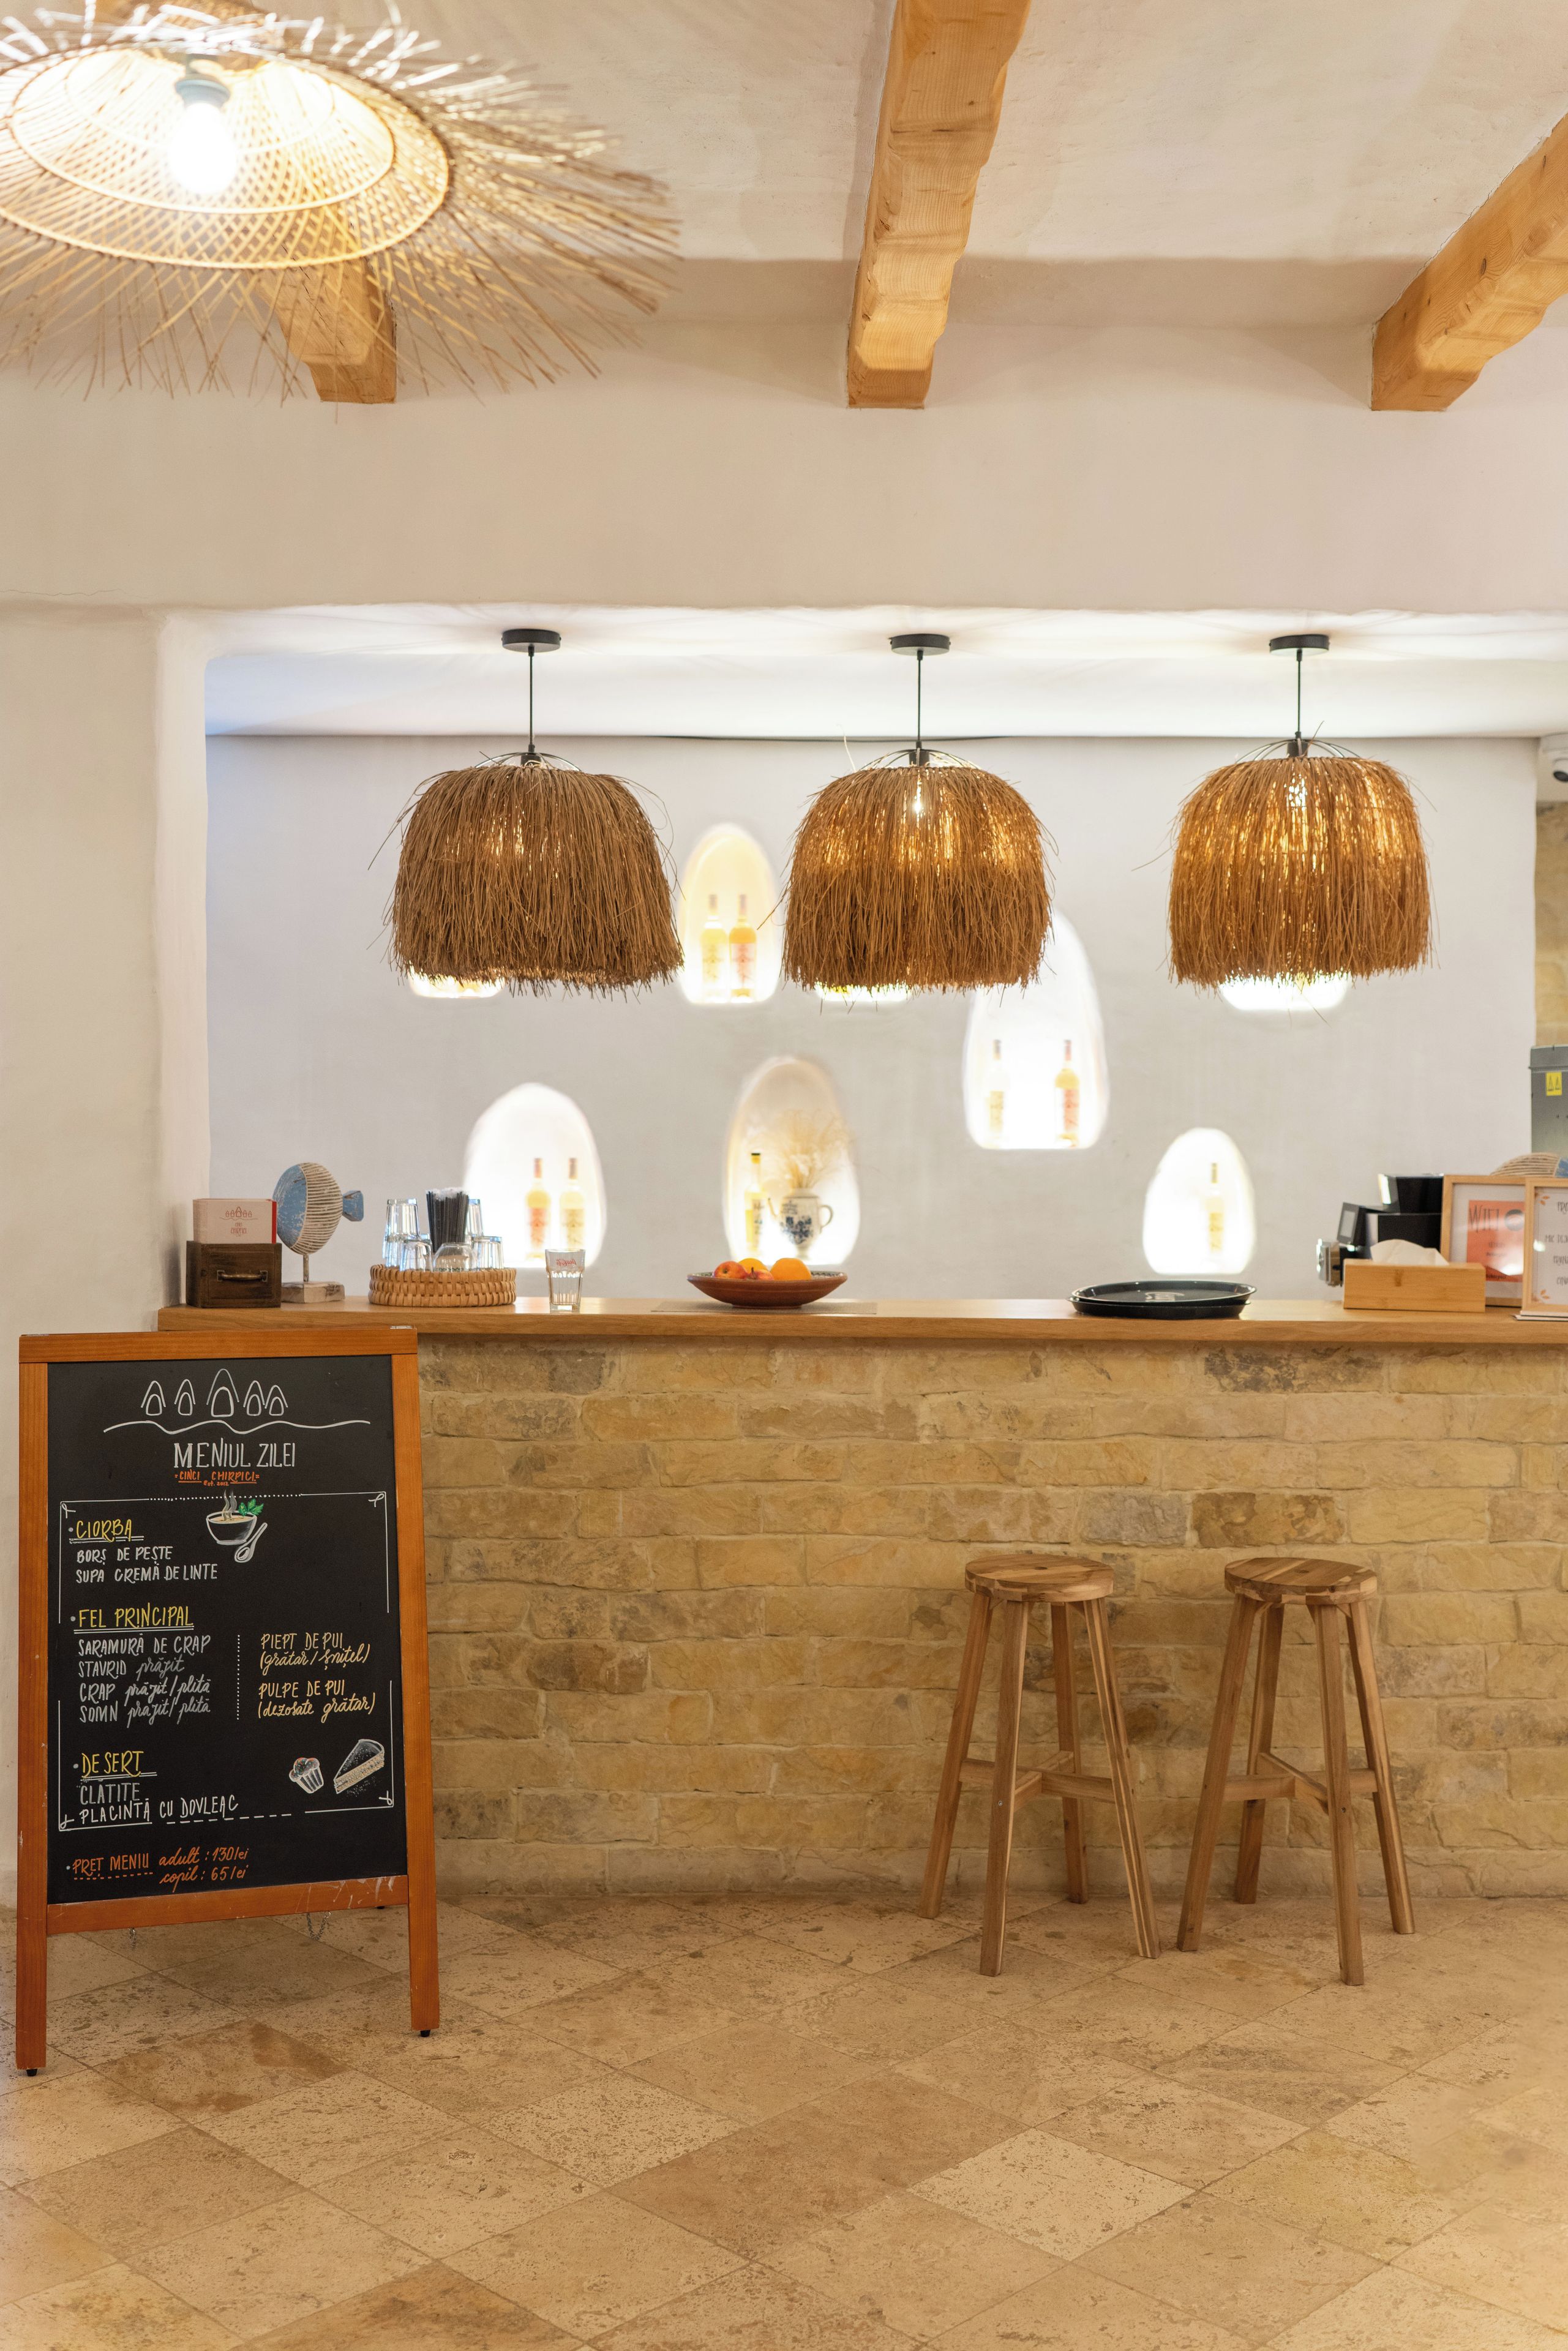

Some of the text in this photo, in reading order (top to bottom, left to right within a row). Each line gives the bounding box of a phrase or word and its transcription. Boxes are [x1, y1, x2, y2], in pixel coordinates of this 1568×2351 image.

[173, 1438, 296, 1468] MENIUL ZILEI
[179, 1469, 200, 1480] CINCI
[117, 1547, 130, 1561] DE
[76, 1569, 104, 1583] SUPA
[163, 1565, 180, 1581] DE
[184, 1564, 217, 1580] LINTE
[79, 1602, 193, 1628] FEL PRINCIPAL
[154, 1637, 167, 1654] DE
[174, 1635, 211, 1655] CRAP
[261, 1633, 297, 1649] PIEPT
[305, 1632, 319, 1651] DE
[78, 1660, 126, 1679] STAVRID
[80, 1683, 116, 1704] CRAP
[258, 1679, 345, 1700] PULPE DE PUI
[80, 1700, 118, 1723] SOMN
[160, 1800, 173, 1818] CU
[180, 1794, 239, 1818] DOVLEAC
[110, 1853, 149, 1871] MENIU
